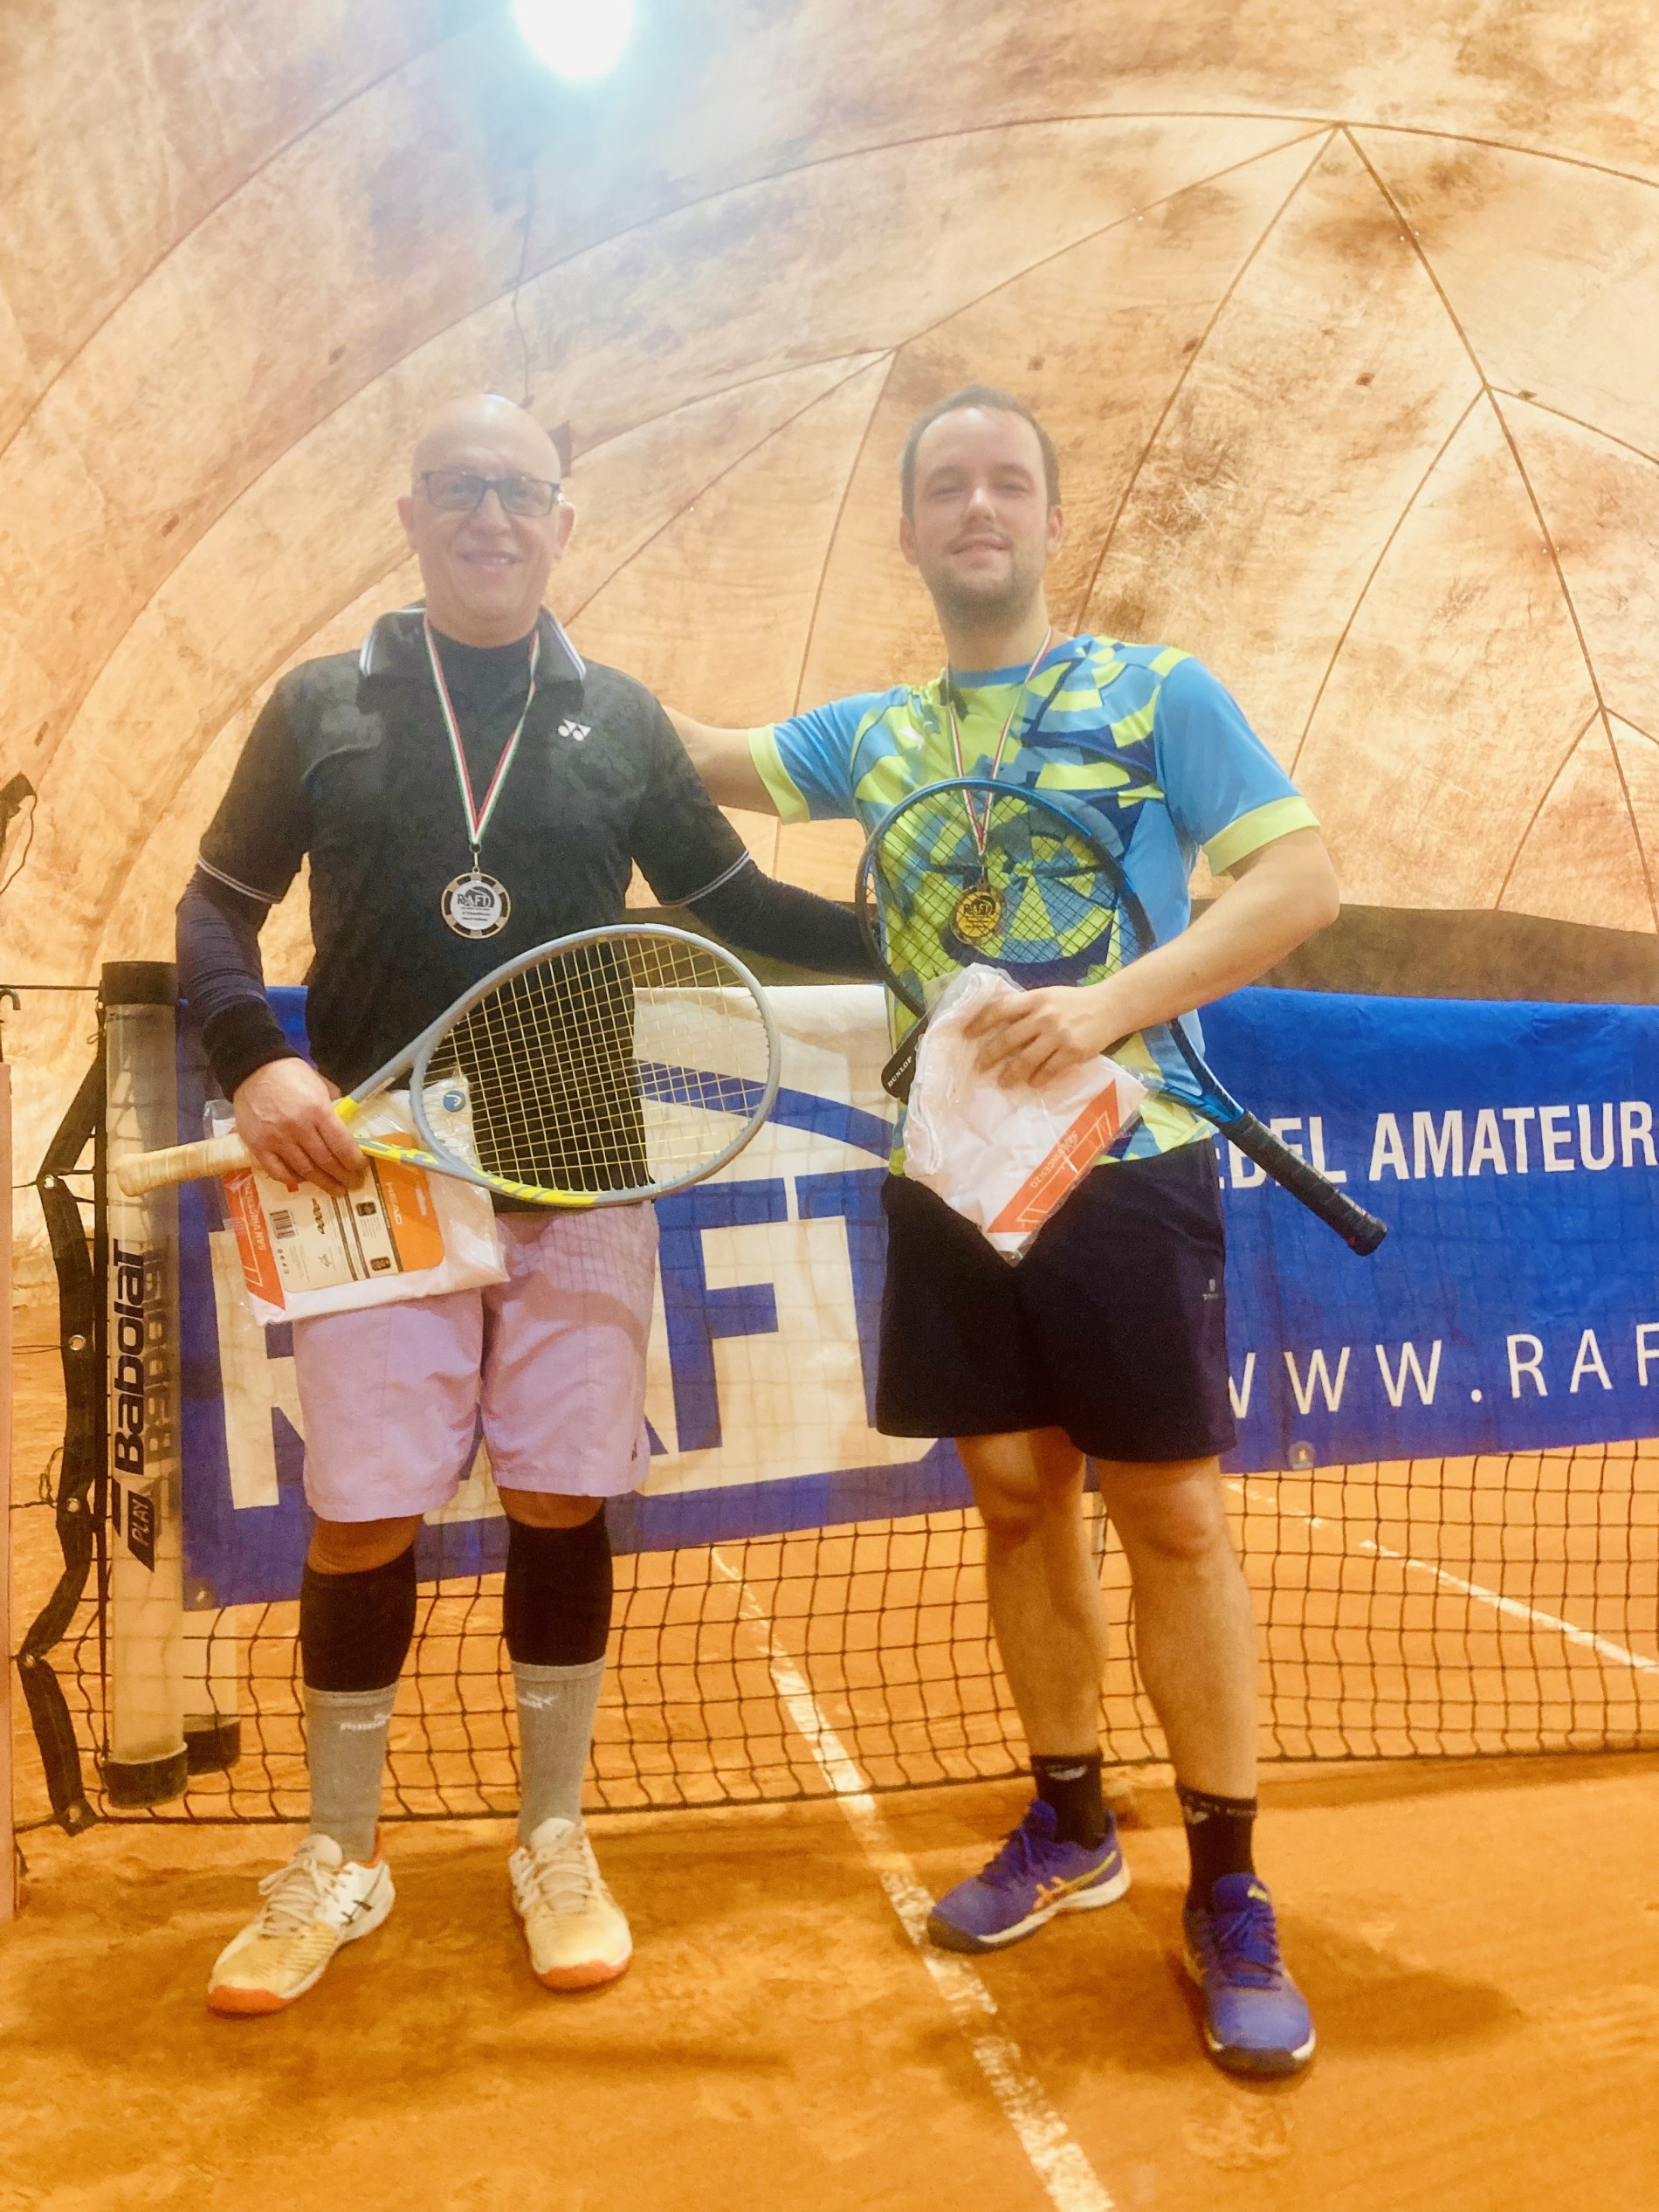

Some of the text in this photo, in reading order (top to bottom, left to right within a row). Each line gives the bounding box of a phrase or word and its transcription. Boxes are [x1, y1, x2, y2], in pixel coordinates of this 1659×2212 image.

[887, 1056, 912, 1089] DUNLOP
[1215, 1101, 1659, 1189] BEL AMATEUR
[385, 1181, 403, 1225] HEAD
[255, 1230, 267, 1251] SAN
[131, 1498, 150, 1547] PLAY
